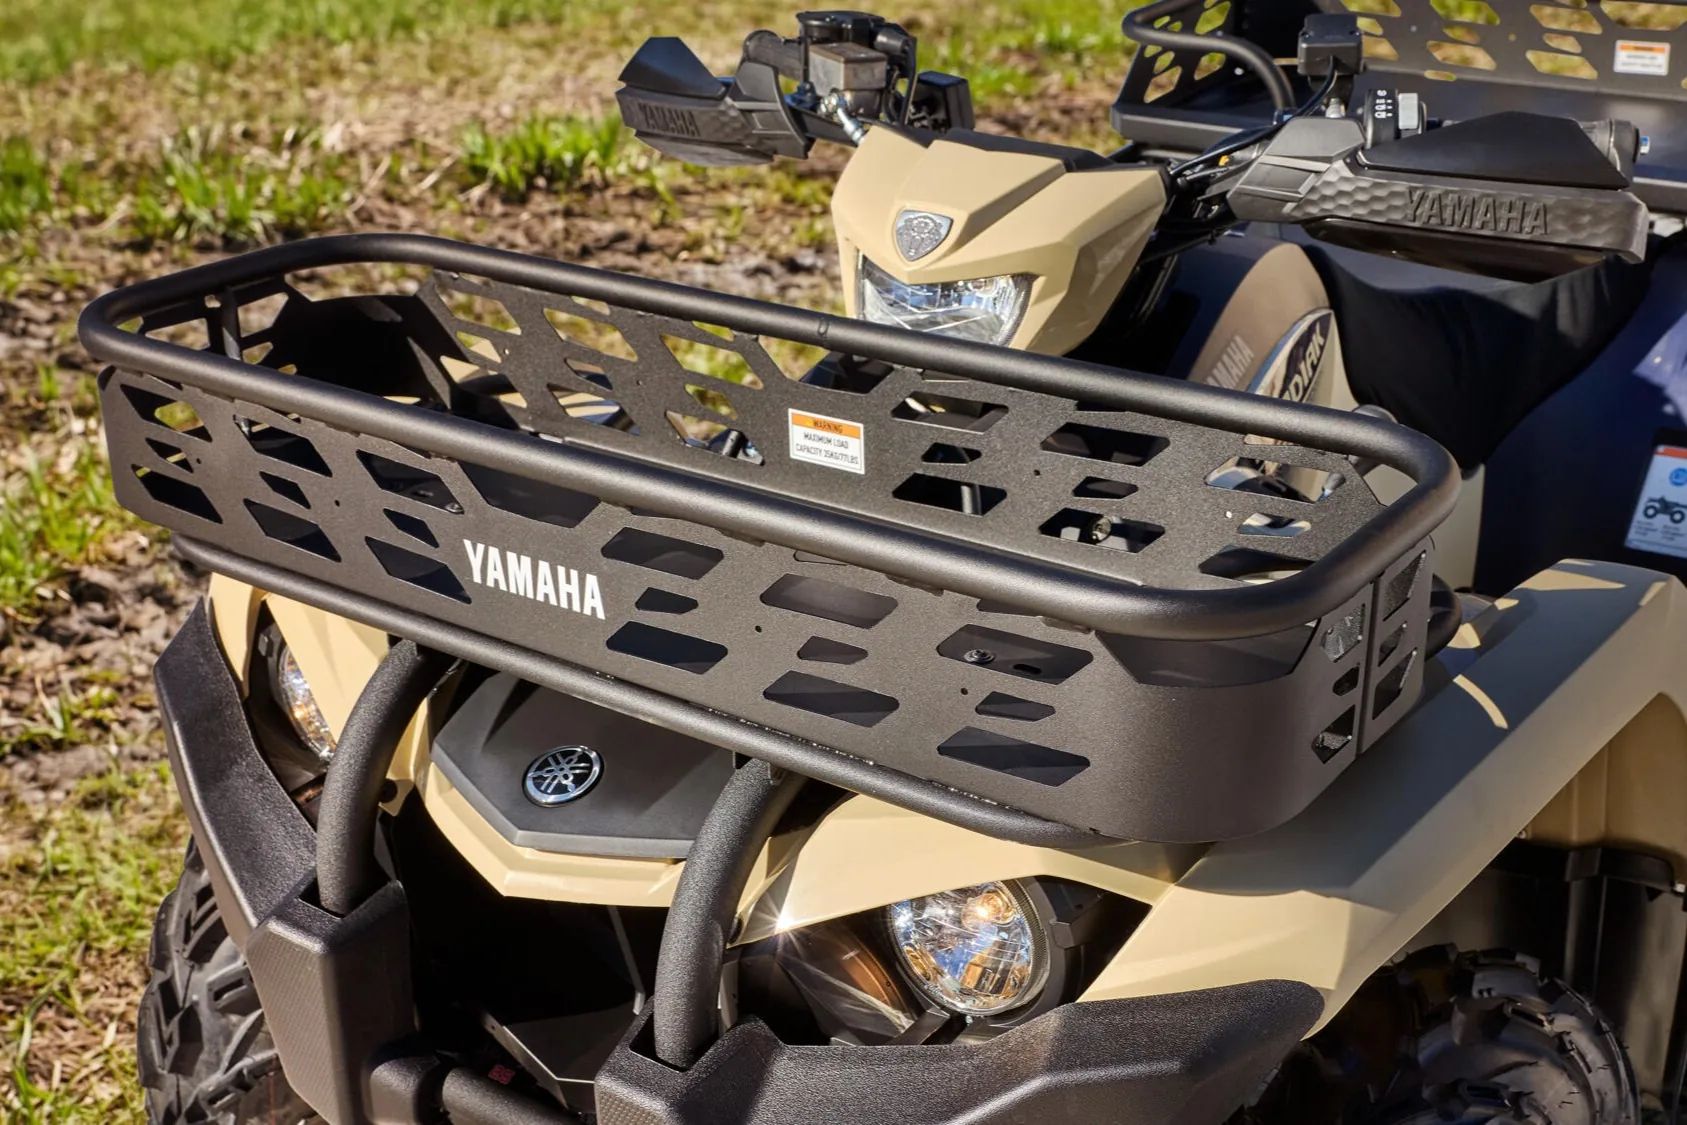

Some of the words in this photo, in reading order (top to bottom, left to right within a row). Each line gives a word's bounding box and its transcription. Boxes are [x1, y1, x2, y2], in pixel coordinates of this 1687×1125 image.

[637, 102, 701, 137] YAMAHA
[1408, 188, 1550, 235] YAMAHA
[1205, 335, 1254, 389] MAHA
[1282, 321, 1325, 402] DIAK
[803, 431, 832, 446] MAXIMUM
[833, 438, 849, 449] LOAD
[813, 418, 843, 434] WARNING
[796, 443, 822, 457] CAPACITY
[463, 538, 606, 620] YAMAHA
